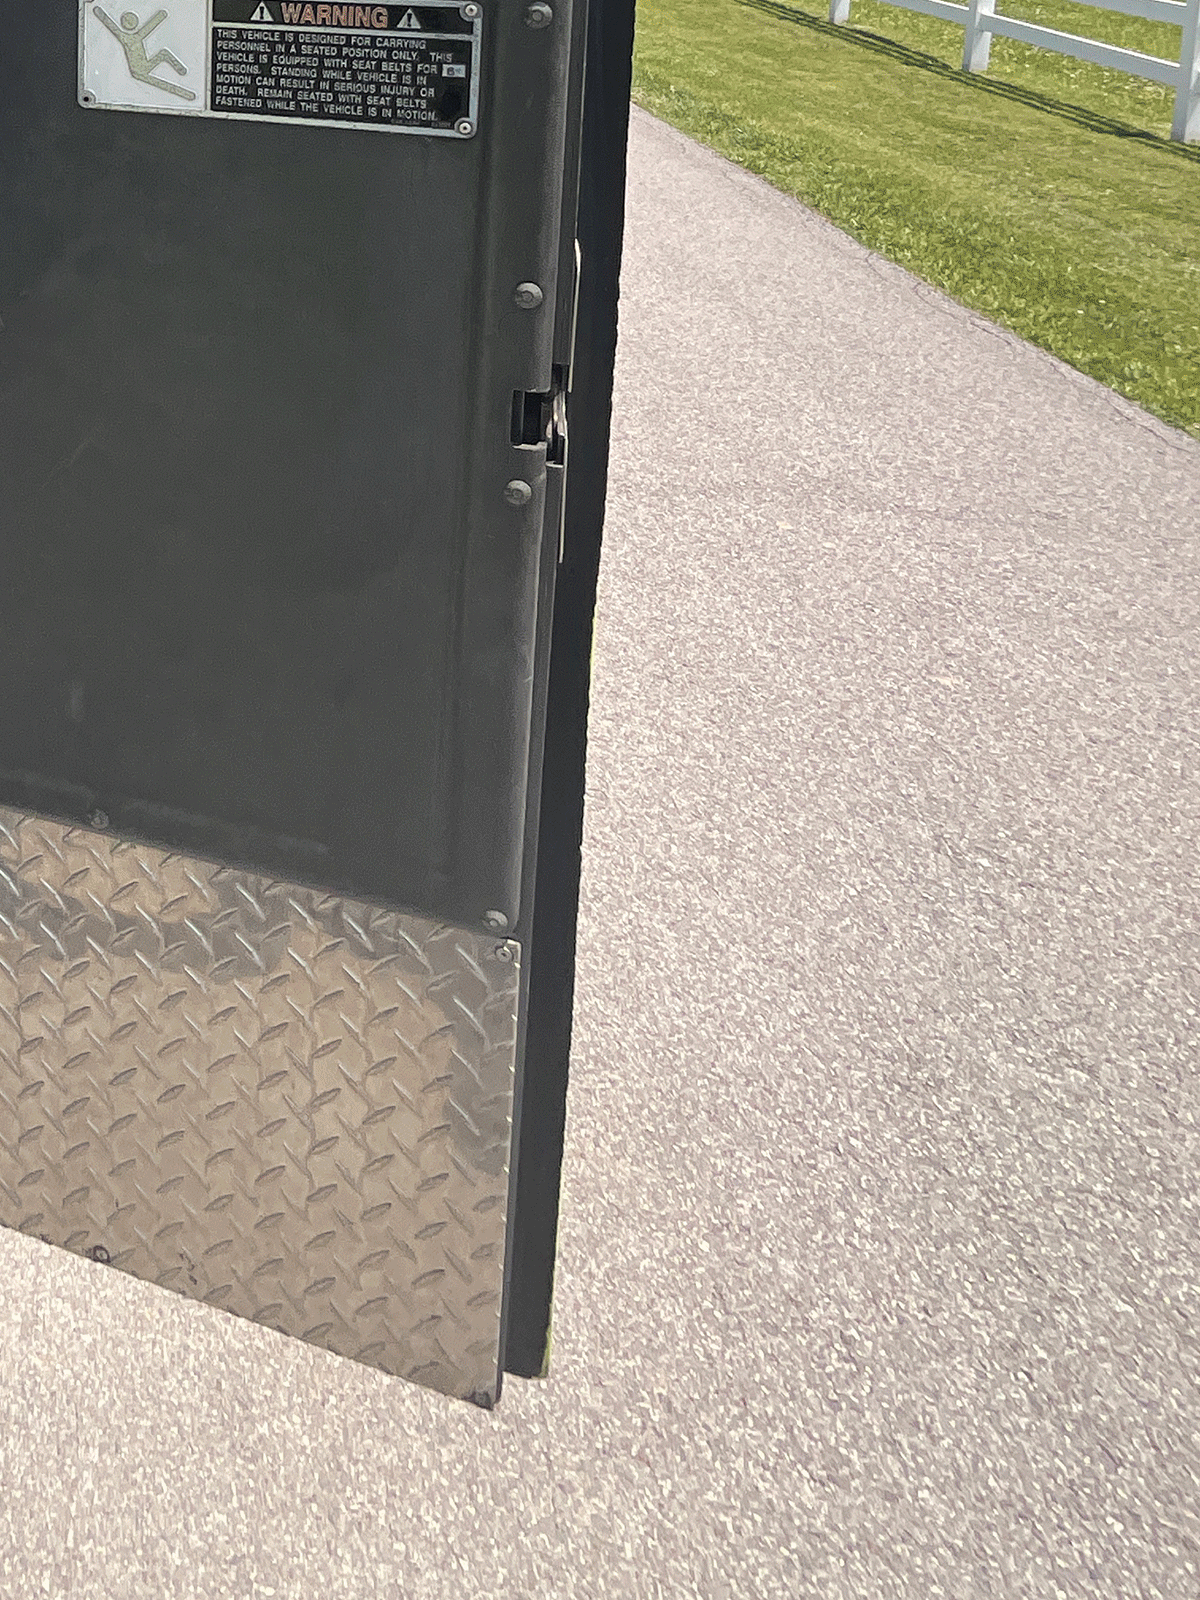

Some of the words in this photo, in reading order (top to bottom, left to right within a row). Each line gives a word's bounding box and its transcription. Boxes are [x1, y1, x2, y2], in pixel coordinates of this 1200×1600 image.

[281, 2, 388, 29] WARNING
[217, 29, 237, 39] THIS
[242, 30, 280, 41] VEHICLE
[285, 32, 294, 42] IS
[299, 33, 346, 45] DESIGNED
[351, 36, 371, 46] FOR
[376, 37, 427, 49] CARRYING
[216, 51, 254, 63] VEHICLE
[259, 54, 268, 63] IS
[272, 55, 319, 67] EQUIPPED
[323, 58, 347, 68] WITH
[352, 60, 377, 70] SEAT
[381, 62, 412, 73] BELTS
[417, 63, 438, 74] FOR
[217, 41, 271, 52] PERSONNEL
[275, 44, 285, 53] IN
[290, 44, 297, 53] A
[301, 45, 337, 55] SEATED
[342, 47, 387, 59] POSITION
[429, 52, 453, 63] THIS
[216, 74, 251, 85] MOTION
[255, 77, 275, 87] CAN
[280, 78, 315, 89] RESULT
[319, 81, 330, 90] IN
[334, 82, 376, 94] SERIOUS
[380, 85, 416, 96] INJURY
[420, 87, 435, 98] OR
[270, 66, 317, 78] STANDING
[322, 70, 352, 80] WHILE
[357, 71, 398, 83] VEHICLE
[402, 75, 412, 84] IS
[416, 76, 427, 85] IN
[215, 96, 262, 108] FASTENED
[266, 99, 296, 111] WHILE
[300, 102, 319, 113] THE
[323, 103, 363, 116] VEHICLE
[367, 107, 377, 117] IS
[381, 108, 392, 118] IN
[257, 88, 293, 99] REMAIN
[297, 91, 333, 102] SEATED
[338, 93, 362, 104] WITH
[366, 95, 391, 106] SEAT
[396, 97, 427, 109] BELTS
